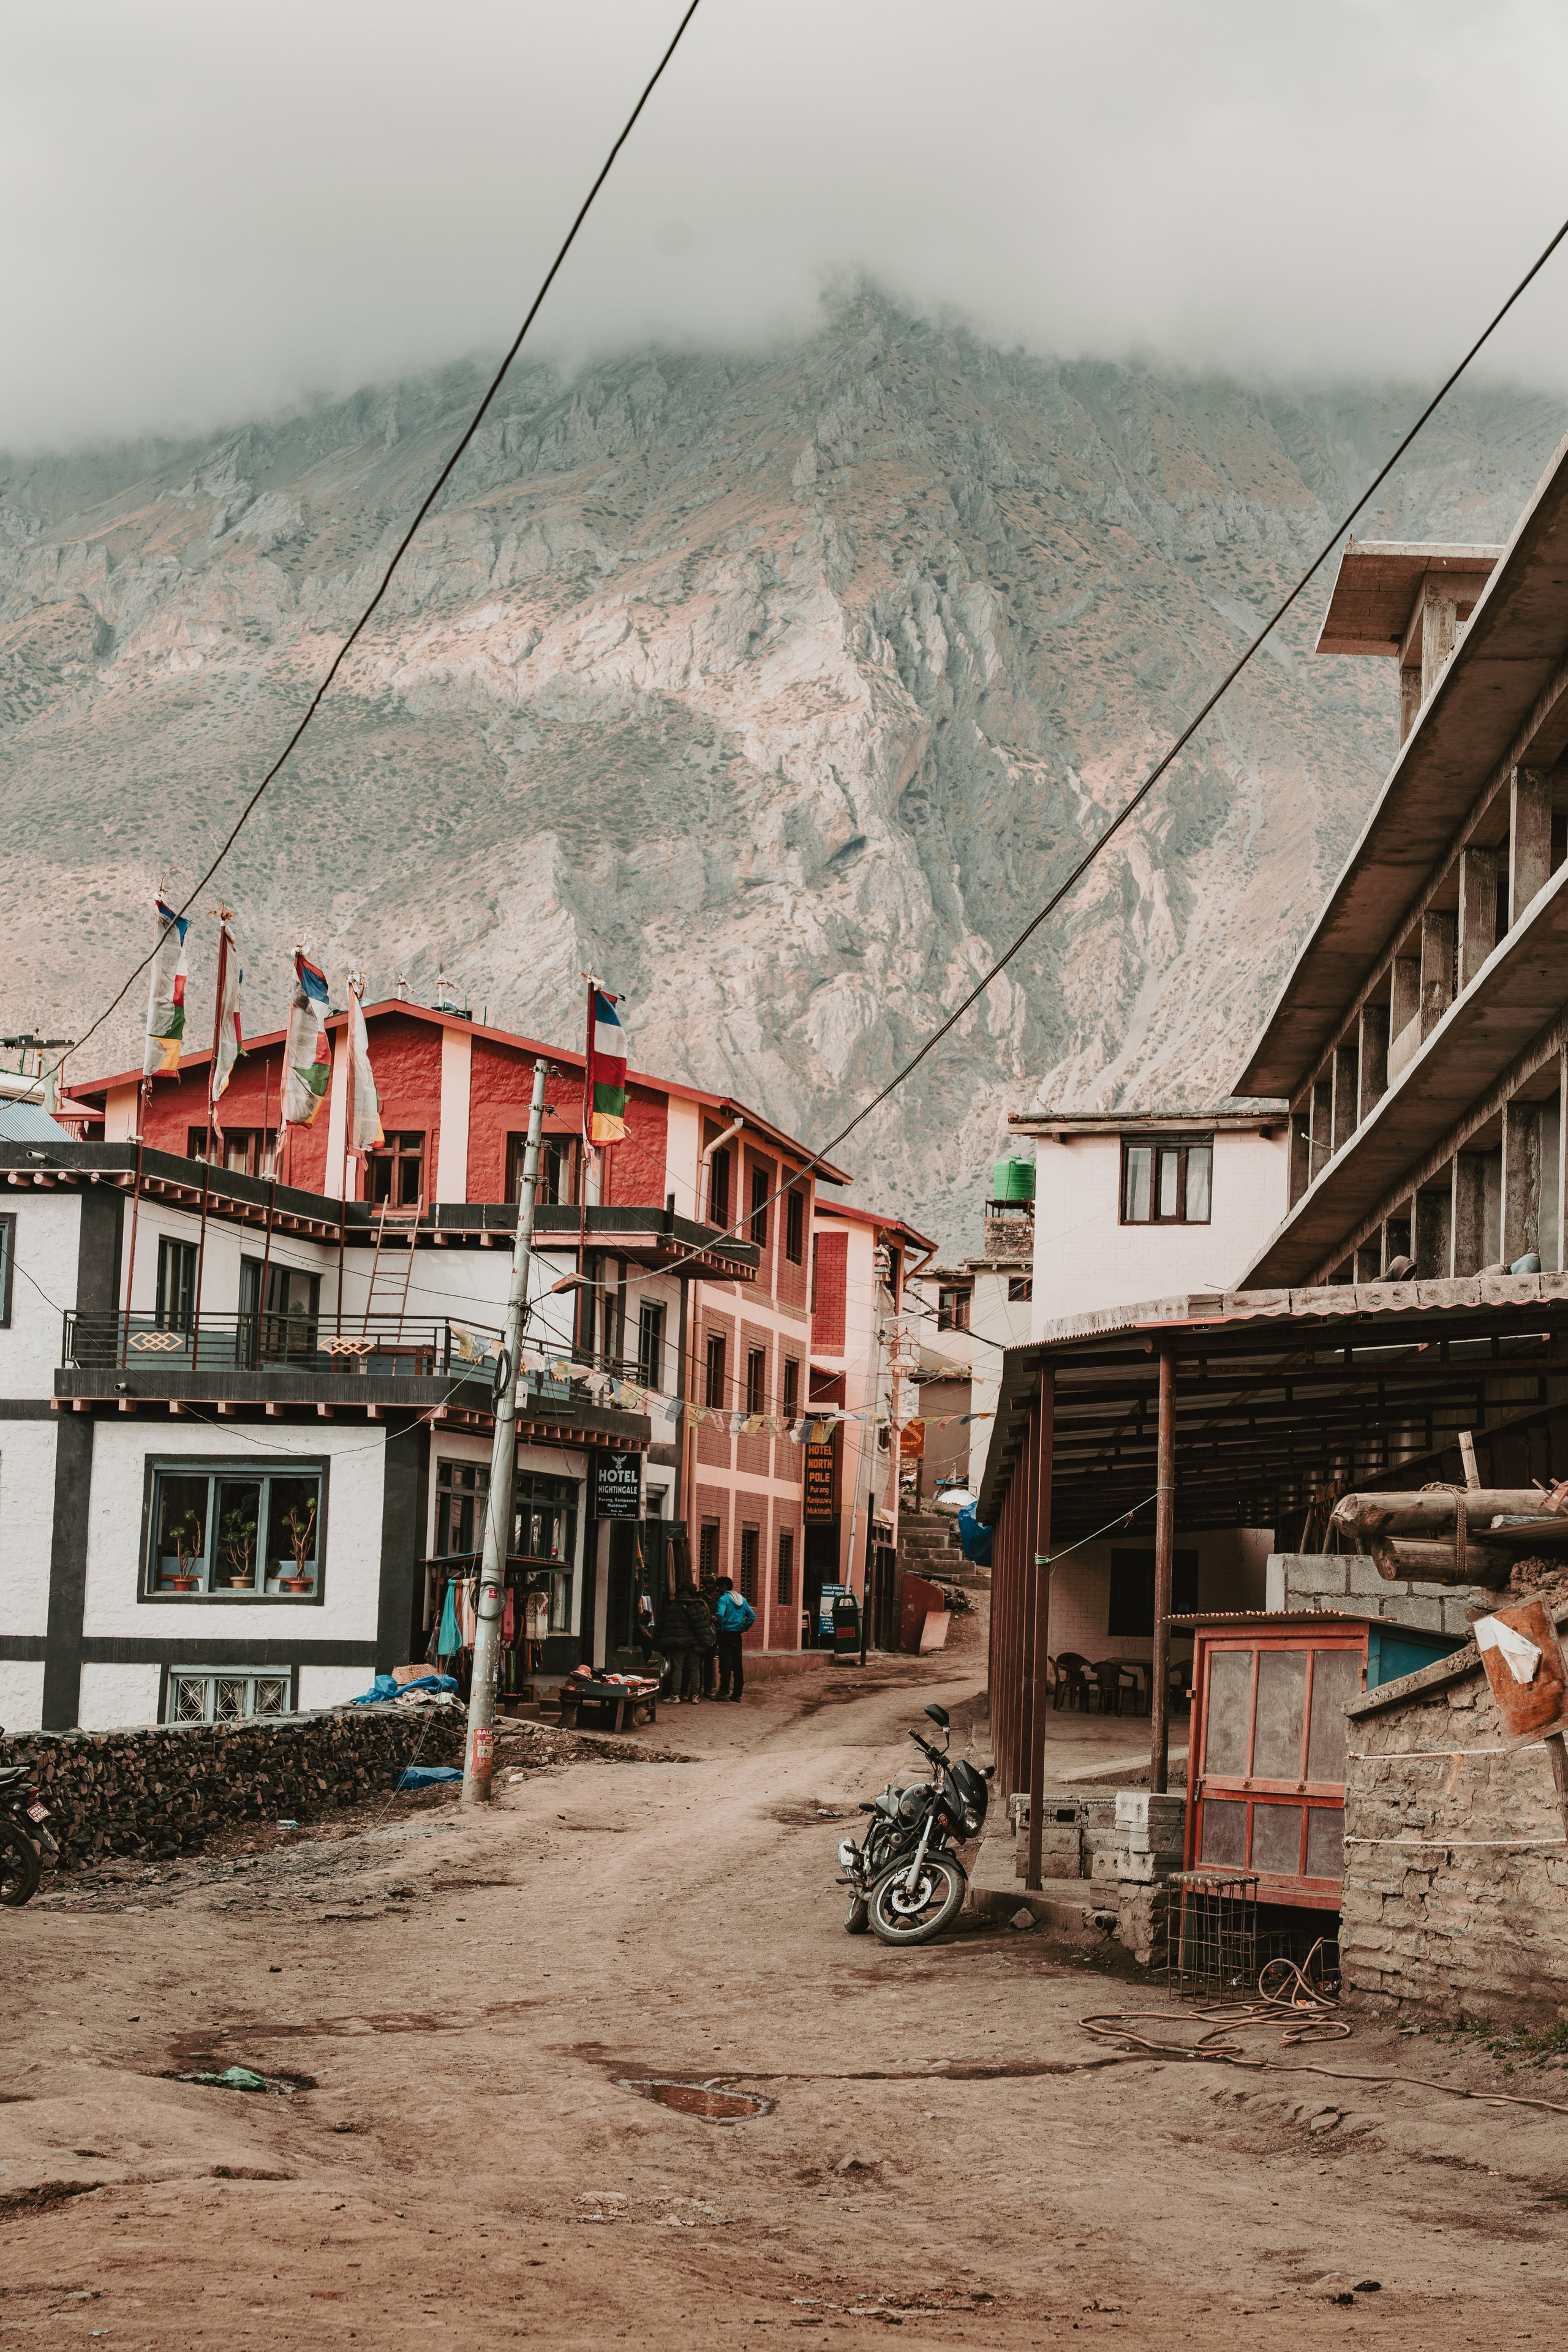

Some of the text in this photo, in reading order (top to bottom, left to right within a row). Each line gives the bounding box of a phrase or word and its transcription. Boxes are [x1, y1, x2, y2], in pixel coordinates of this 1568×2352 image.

[809, 1445, 832, 1455] HOTEL
[808, 1458, 832, 1469] NORTH
[598, 1469, 638, 1483] HOTEL
[809, 1472, 830, 1482] POLE
[598, 1485, 637, 1494] NIGHTINGALE
[810, 1485, 829, 1495] Purang
[807, 1496, 832, 1505] Ranipauwa
